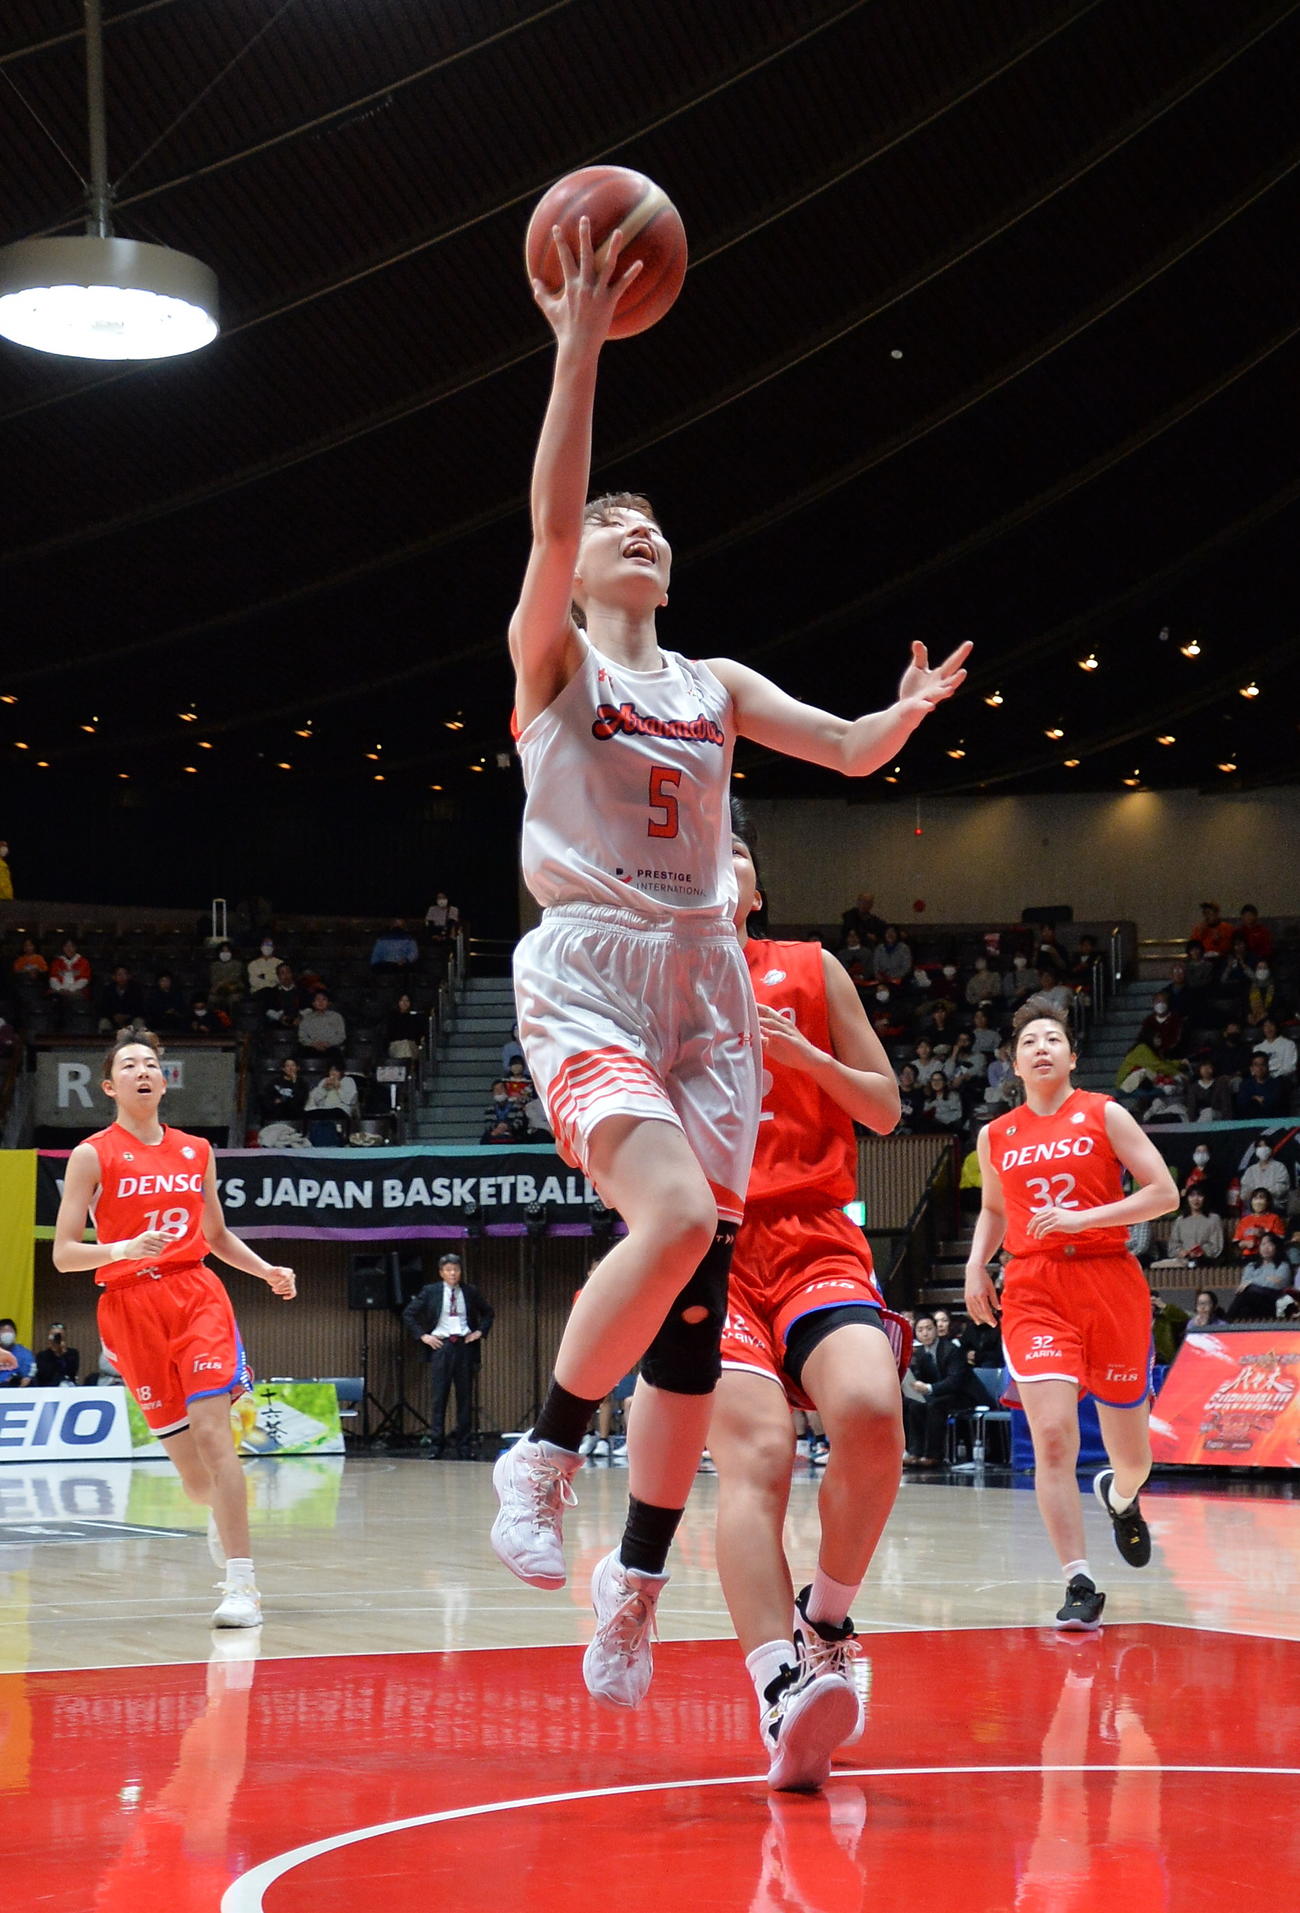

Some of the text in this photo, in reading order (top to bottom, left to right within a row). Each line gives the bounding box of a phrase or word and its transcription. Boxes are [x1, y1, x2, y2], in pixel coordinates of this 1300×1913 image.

[648, 766, 682, 839] 5
[637, 869, 692, 882] PRESTIGE
[58, 1063, 94, 1108] R
[1001, 1136, 1094, 1171] DENSO
[117, 1173, 203, 1198] DENSO
[255, 1177, 373, 1209] JAPAN
[383, 1174, 601, 1208] BASKETBALL
[1026, 1173, 1079, 1213] 32
[143, 1207, 190, 1240] 18
[1025, 1349, 1063, 1360] KARIYA
[1031, 1335, 1055, 1350] 32
